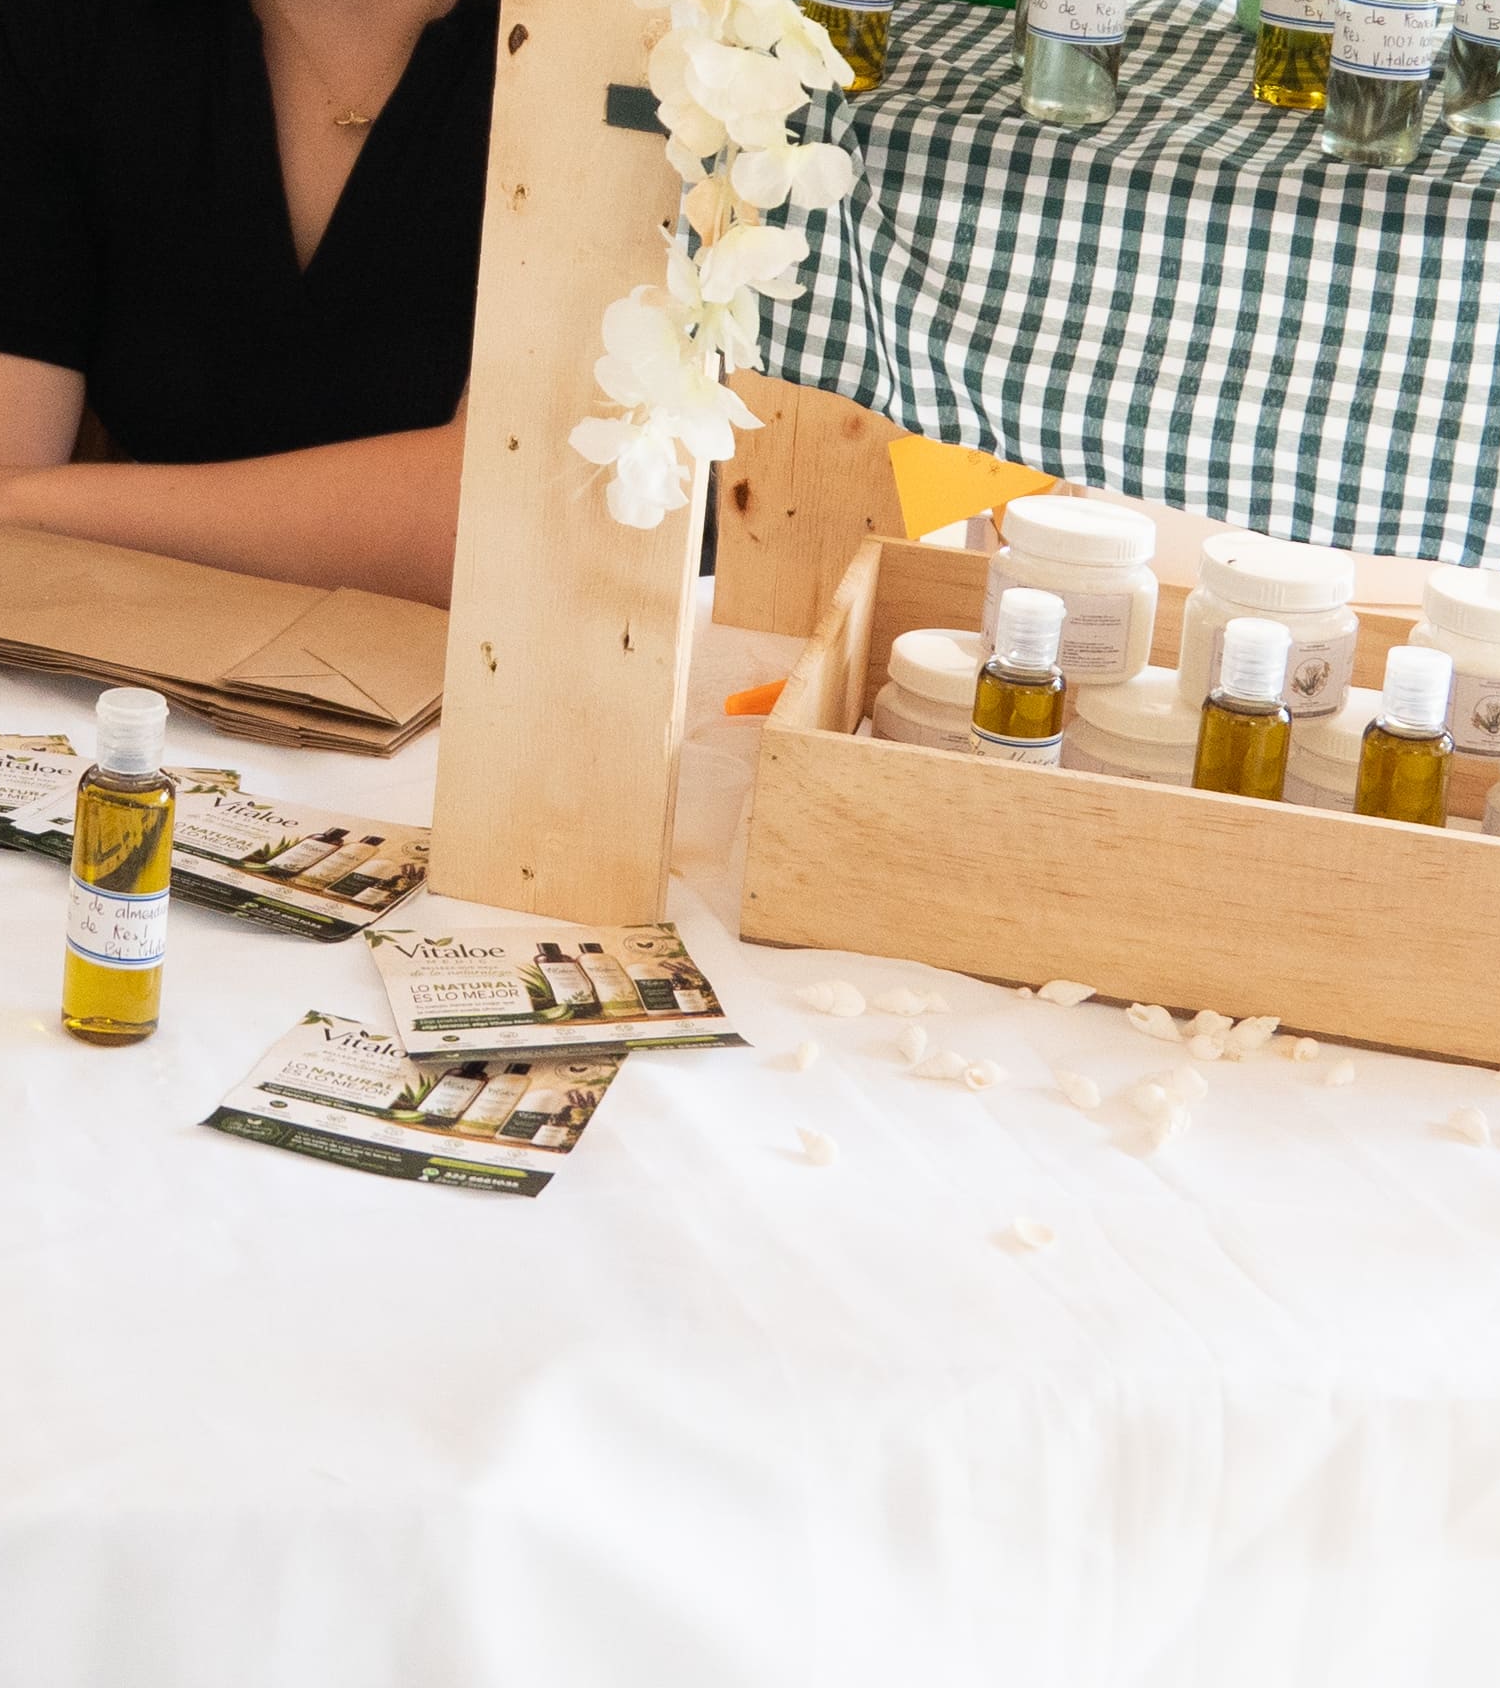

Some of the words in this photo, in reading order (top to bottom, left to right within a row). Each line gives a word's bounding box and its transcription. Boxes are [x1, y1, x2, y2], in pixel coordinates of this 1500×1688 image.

[1364, 9, 1388, 26] de
[211, 795, 300, 828] Vitaloe
[186, 824, 254, 848] NATURAL
[201, 832, 251, 852] MEJOR
[88, 895, 105, 916] de
[80, 915, 98, 934] de
[394, 943, 506, 959] Vitaloe
[410, 984, 430, 994] LO
[433, 981, 518, 992] NATURAL
[413, 994, 432, 1004] ES
[437, 992, 459, 1002] LO
[463, 989, 520, 1000] MEJOR
[323, 1027, 409, 1060] Vitalo
[286, 1061, 308, 1071] LO
[311, 1066, 394, 1091] NATURAL
[306, 1072, 330, 1082] LO
[331, 1077, 391, 1098] MEJOR
